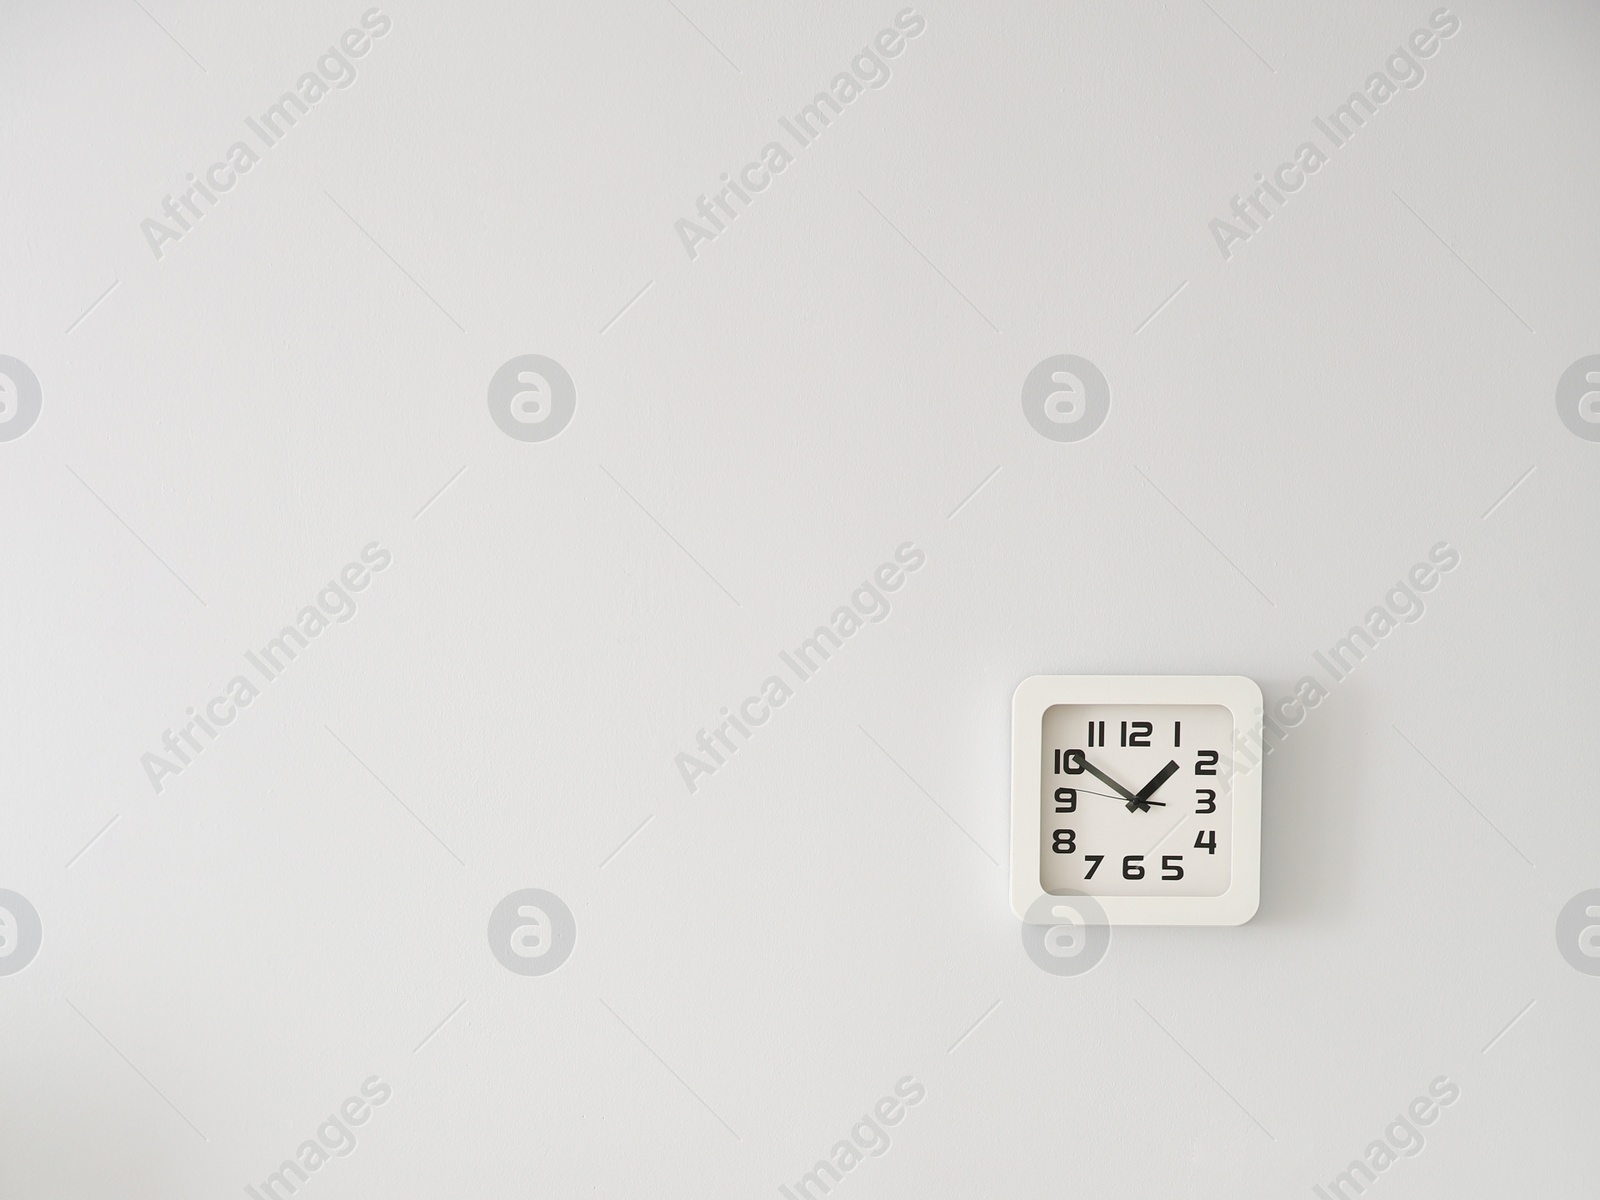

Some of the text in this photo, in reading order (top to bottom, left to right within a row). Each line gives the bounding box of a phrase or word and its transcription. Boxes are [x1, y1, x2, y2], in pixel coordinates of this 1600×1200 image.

[1088, 721, 1105, 747] 11
[1121, 721, 1153, 747] 12
[1174, 721, 1181, 747] 1
[1054, 749, 1086, 775] 10
[1195, 750, 1219, 775] 2
[1054, 788, 1077, 813] 9
[1195, 789, 1217, 814] 3
[1052, 829, 1076, 854] 8
[1193, 830, 1217, 855] 4
[1084, 855, 1105, 880] 7
[1122, 856, 1145, 880] 6
[1161, 856, 1184, 880] 5
